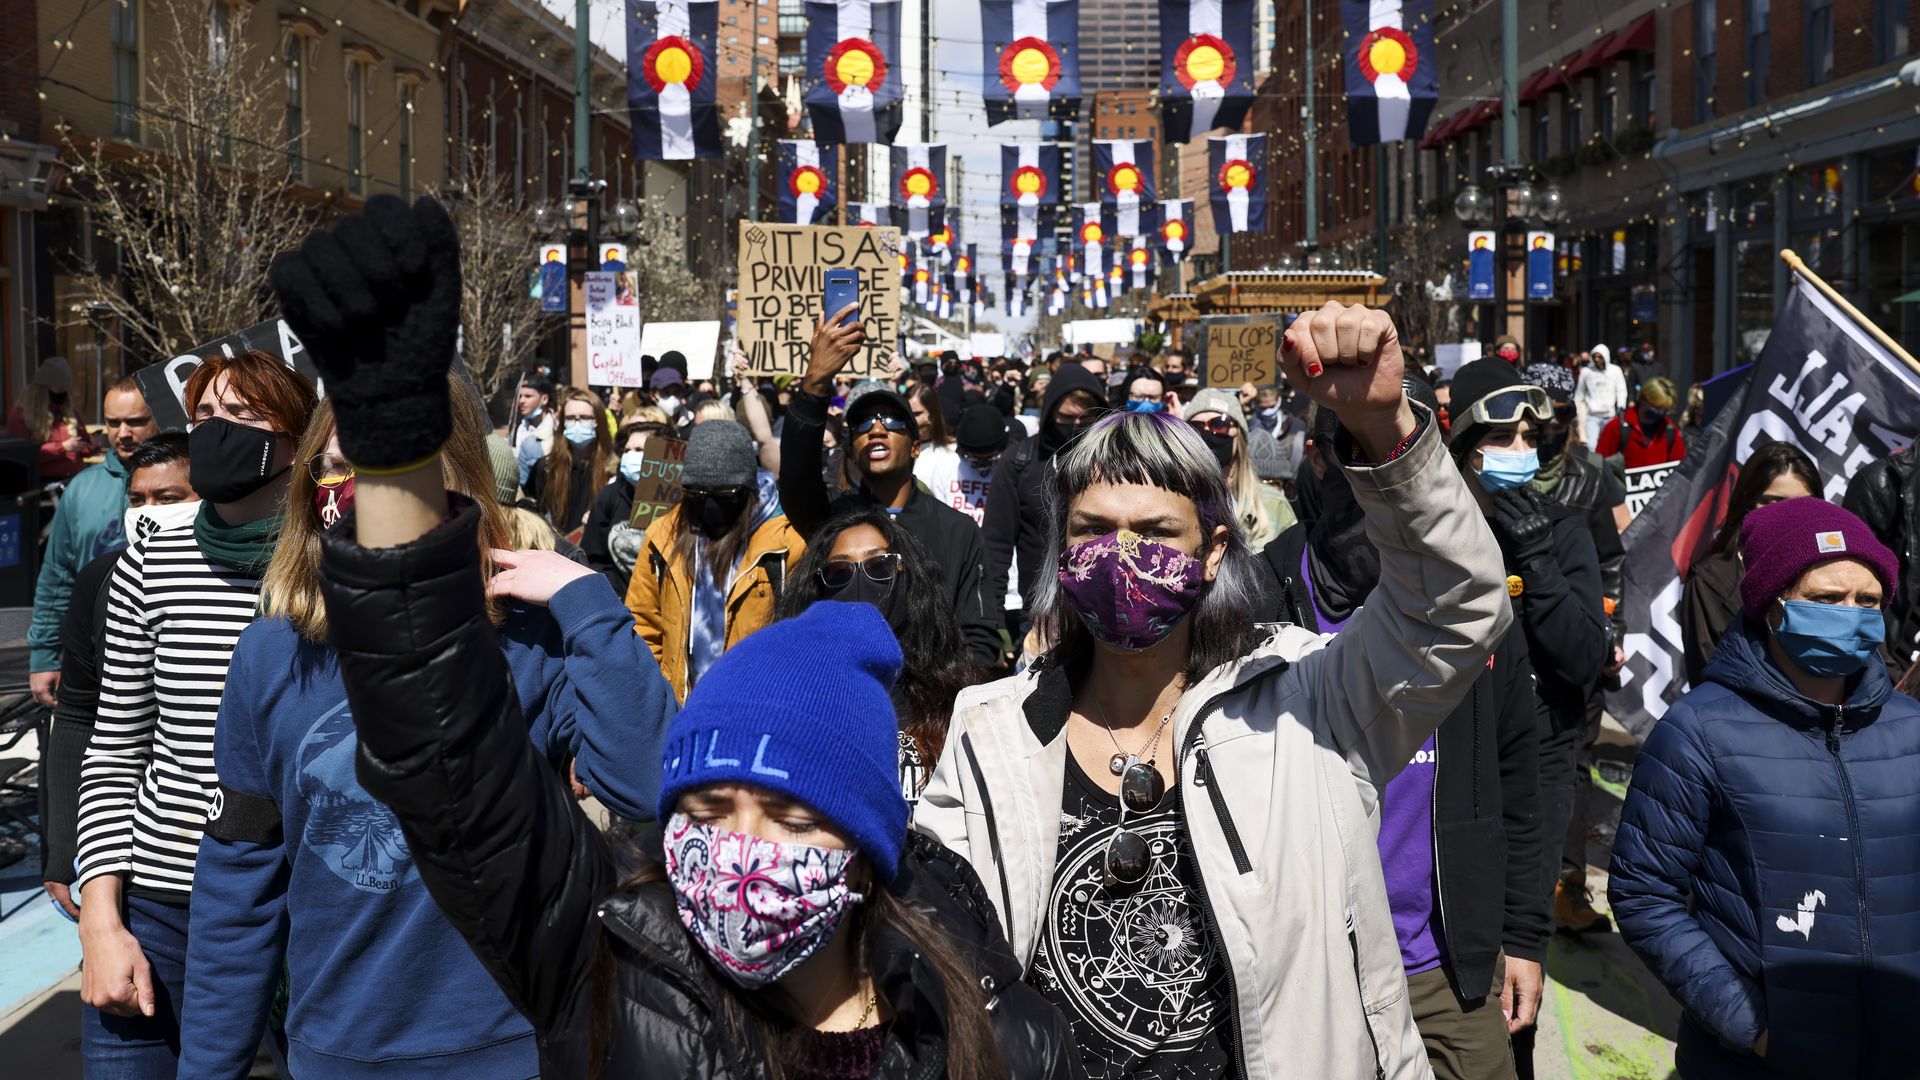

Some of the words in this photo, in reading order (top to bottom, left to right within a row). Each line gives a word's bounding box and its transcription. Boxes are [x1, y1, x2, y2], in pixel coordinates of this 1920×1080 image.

[771, 231, 802, 264] IT
[813, 231, 845, 265] IS
[851, 231, 883, 265] A
[752, 262, 890, 293] PRIVILGE
[746, 295, 781, 317] TO
[787, 293, 888, 317] BELVE
[753, 318, 802, 340] THE
[1209, 328, 1237, 348] ALL
[1239, 325, 1274, 348] COPS
[782, 341, 882, 376] PRCT
[1229, 348, 1255, 364] ARE
[1211, 360, 1266, 383] OPPS
